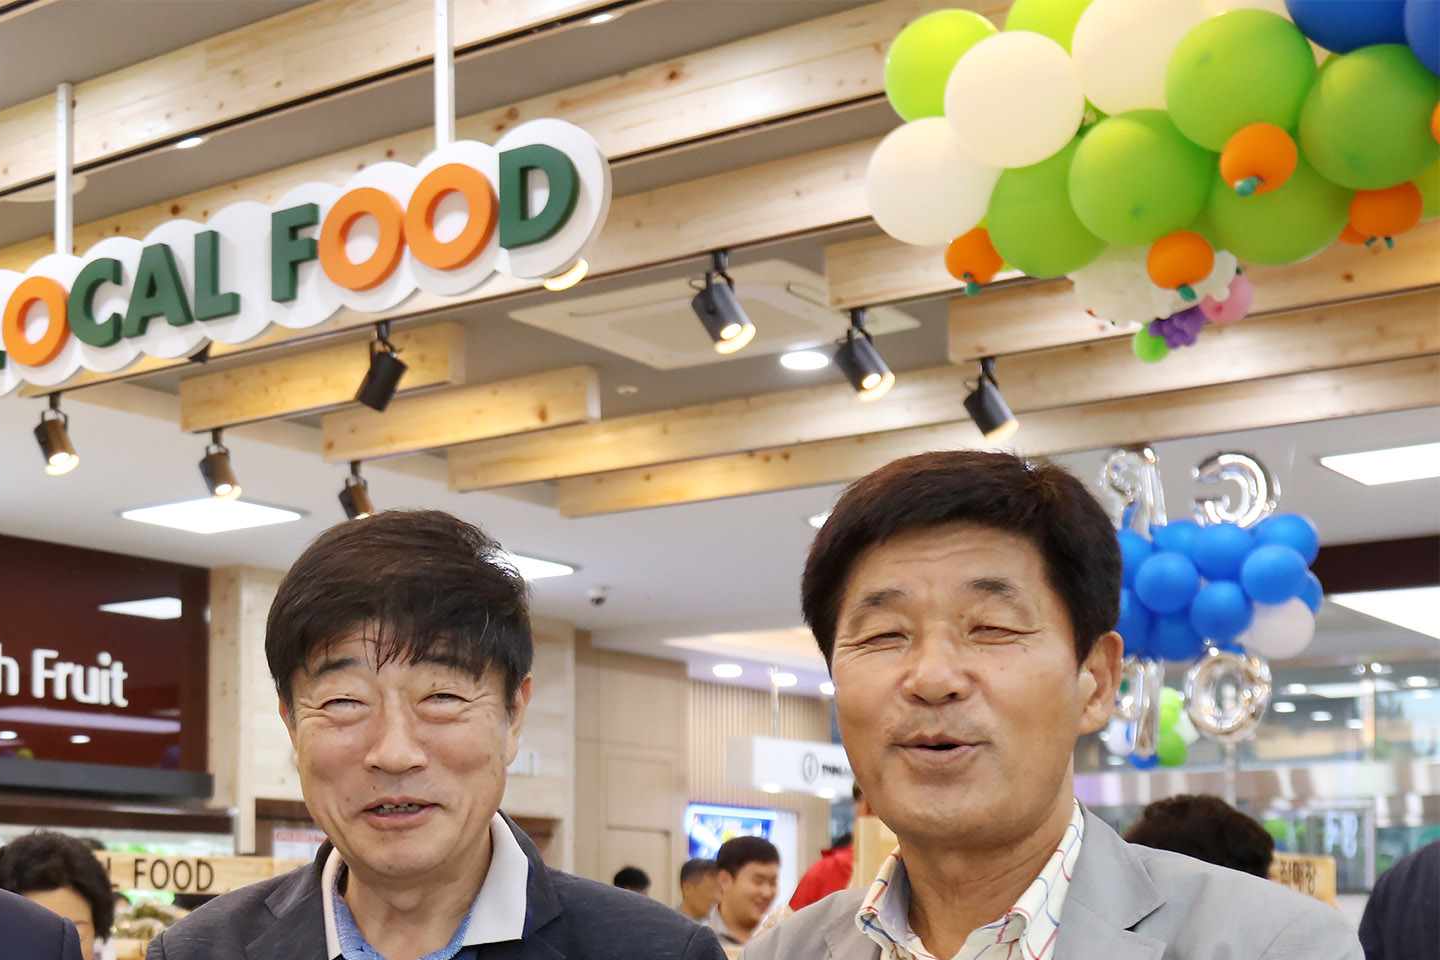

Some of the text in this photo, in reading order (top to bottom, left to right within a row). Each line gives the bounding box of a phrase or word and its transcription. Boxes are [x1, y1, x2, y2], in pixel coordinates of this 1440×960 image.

[271, 144, 579, 302] FOOD
[32, 648, 129, 708] Fruit
[135, 858, 215, 891] FOOD
